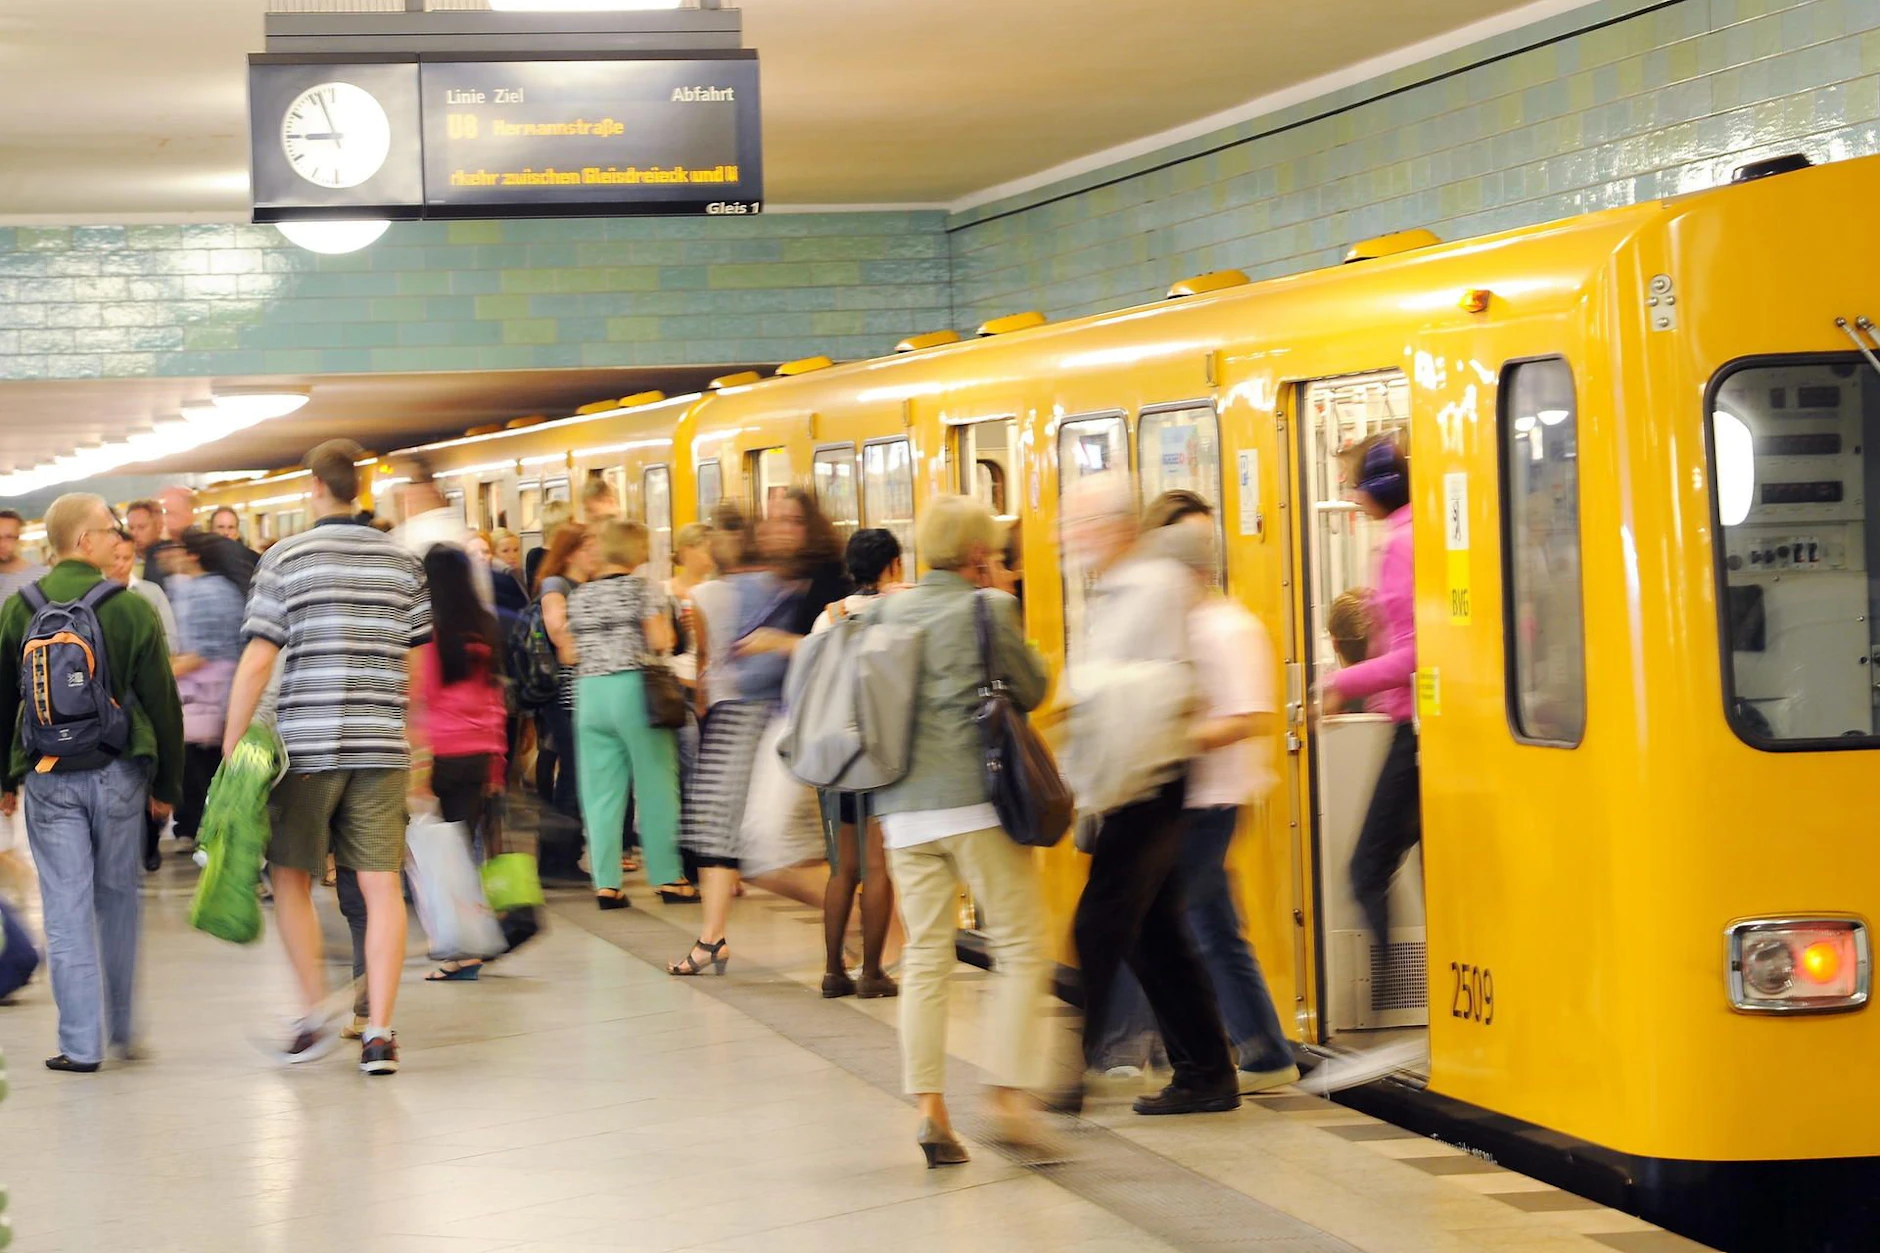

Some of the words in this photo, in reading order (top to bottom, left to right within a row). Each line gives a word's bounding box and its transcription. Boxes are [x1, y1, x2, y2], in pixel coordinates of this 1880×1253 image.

[446, 89, 485, 104] Linie
[493, 88, 524, 103] Ziel
[670, 86, 734, 101] Abfahrt
[447, 114, 478, 139] U8
[493, 118, 625, 137] Hermannstraße
[501, 168, 580, 185] zwischen
[581, 166, 688, 184] Gleisdreieck
[689, 165, 725, 182] und
[706, 202, 747, 214] Gleis
[750, 202, 760, 213] 1
[1452, 588, 1469, 616] BVG
[1451, 961, 1494, 1025] 2509
